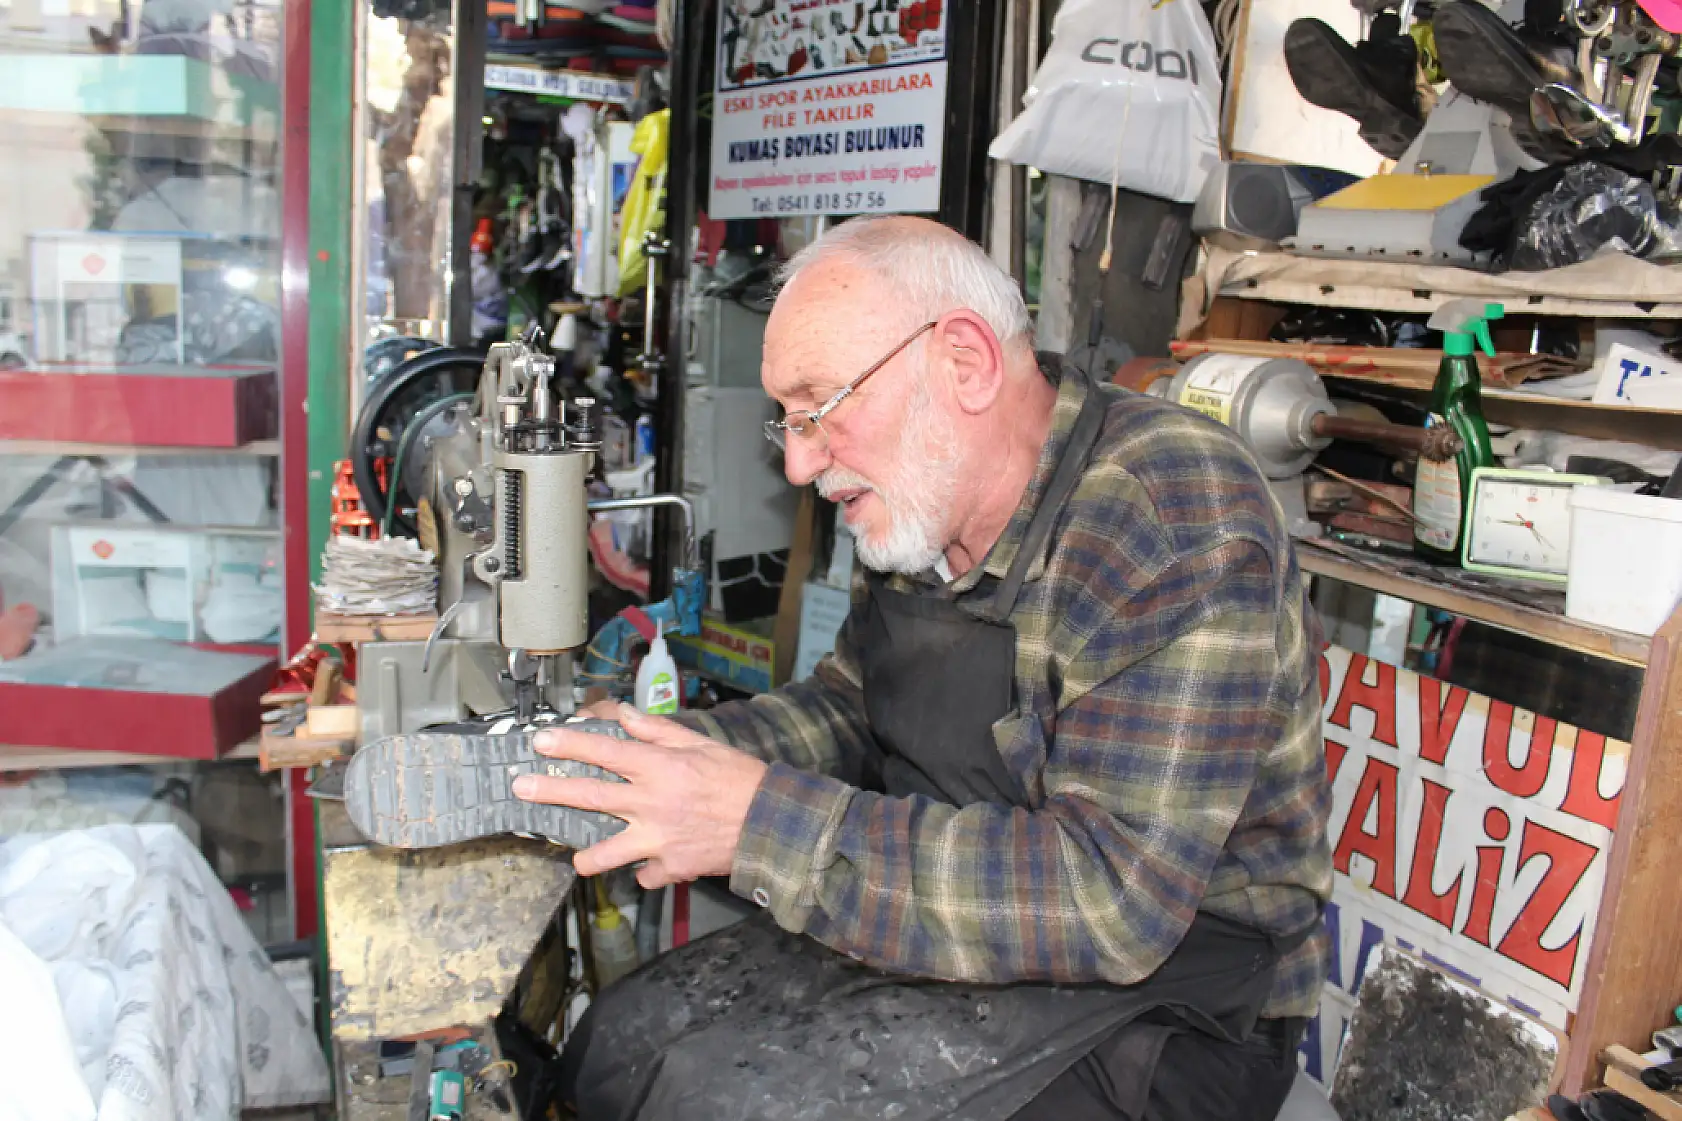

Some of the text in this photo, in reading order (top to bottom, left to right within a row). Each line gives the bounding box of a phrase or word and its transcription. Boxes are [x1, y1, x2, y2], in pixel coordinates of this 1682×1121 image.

[1081, 38, 1199, 86] CODI
[758, 90, 798, 109] SPOR
[802, 72, 933, 103] AYAKKABILARA
[804, 103, 875, 125] TAKILIR
[728, 124, 925, 166] KUMAŞ BOYASI BULUNUR
[777, 195, 809, 212] 0541
[814, 193, 841, 210] 818
[845, 192, 863, 208] 57
[867, 191, 886, 208] 56
